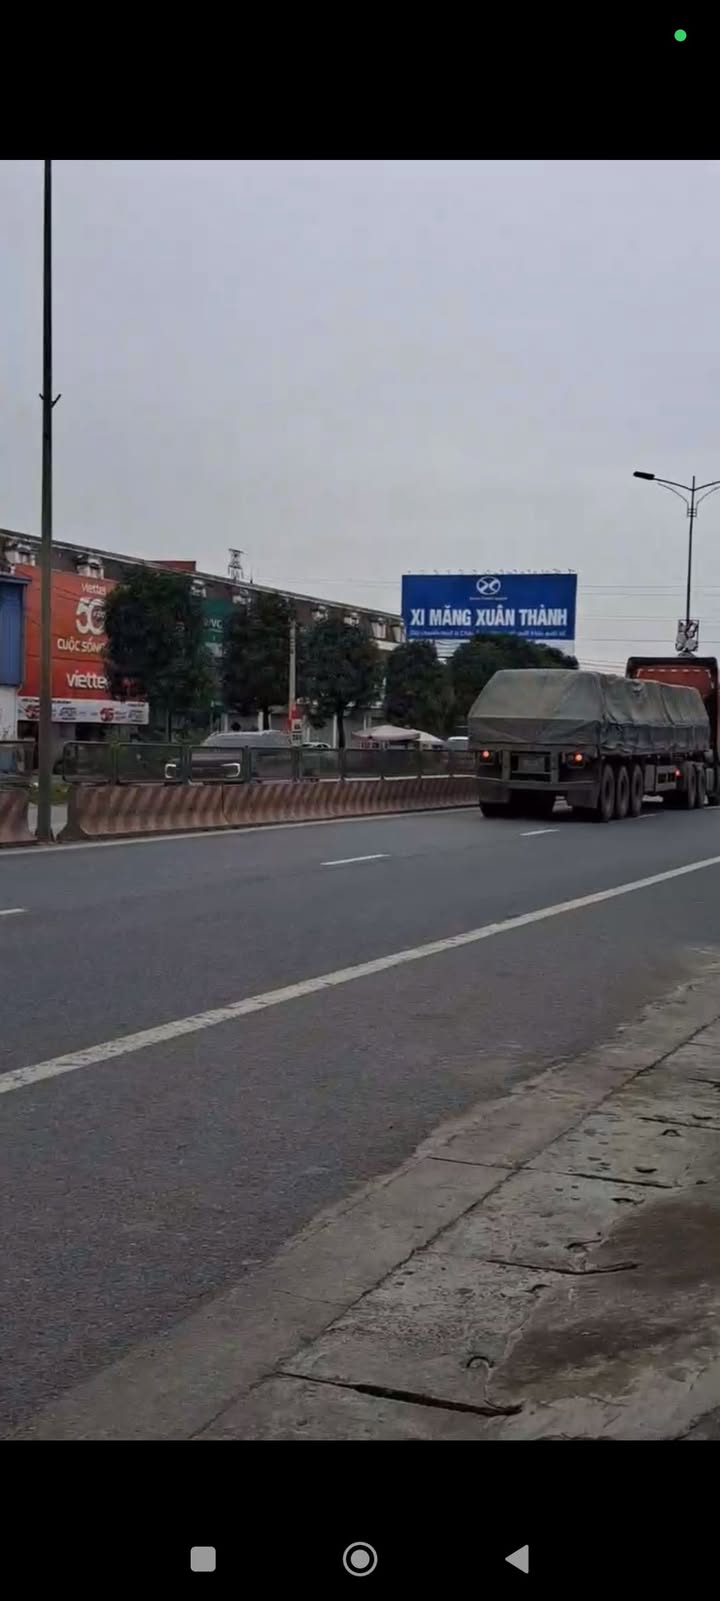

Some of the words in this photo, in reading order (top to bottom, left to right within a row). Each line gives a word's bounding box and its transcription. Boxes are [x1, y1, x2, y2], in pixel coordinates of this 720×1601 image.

[410, 608, 425, 626] XI
[429, 604, 472, 626] MĂNG
[475, 603, 515, 626] XUÂN
[518, 603, 568, 626] THÀNH
[57, 636, 81, 652] CUỘC
[66, 669, 110, 689] viette
